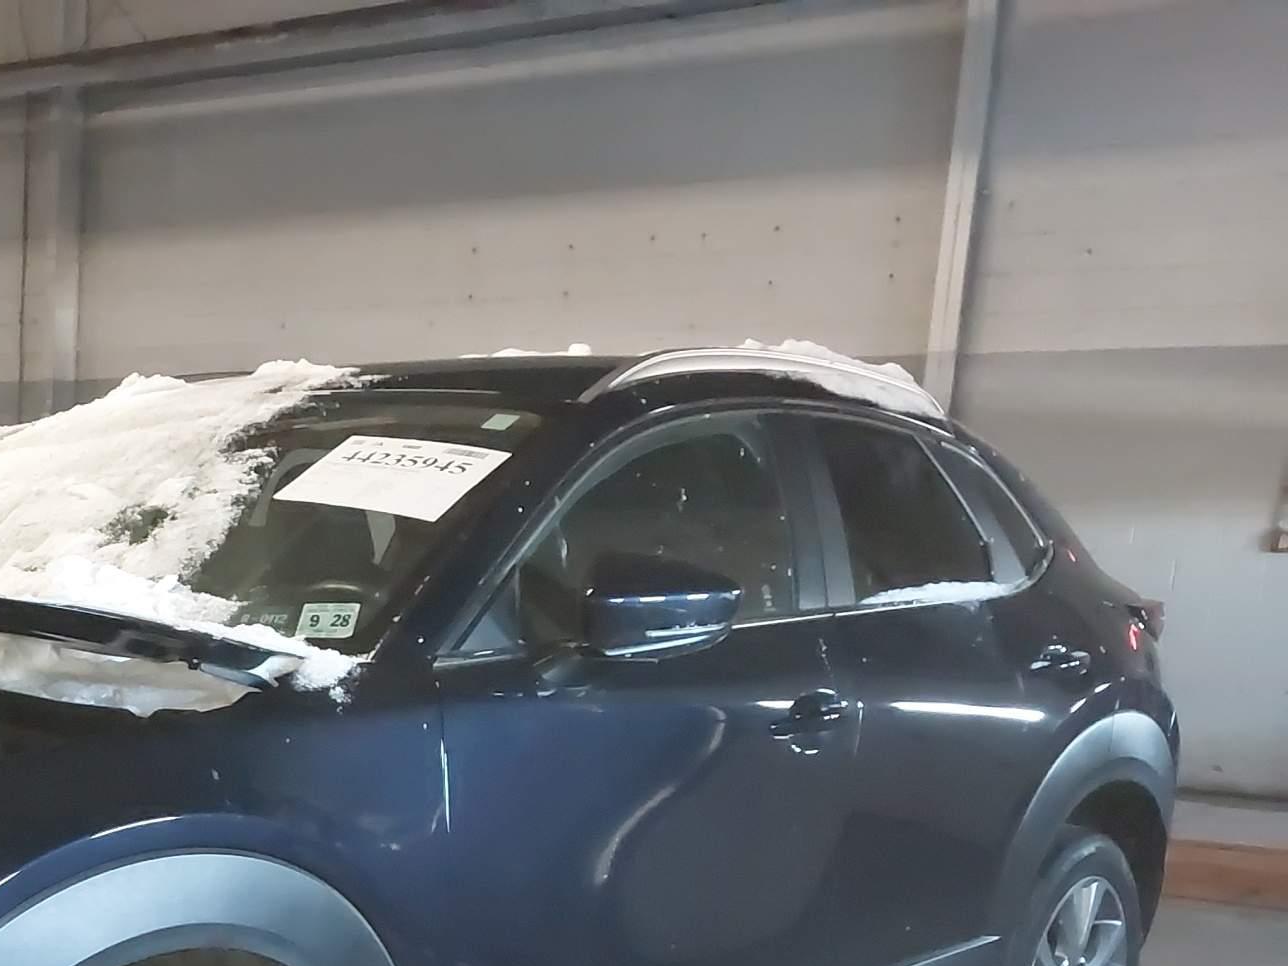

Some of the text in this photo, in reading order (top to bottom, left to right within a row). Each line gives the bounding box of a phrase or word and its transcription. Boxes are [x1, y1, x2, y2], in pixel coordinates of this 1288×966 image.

[341, 450, 473, 475] 44235945
[309, 614, 351, 628] 9 28
